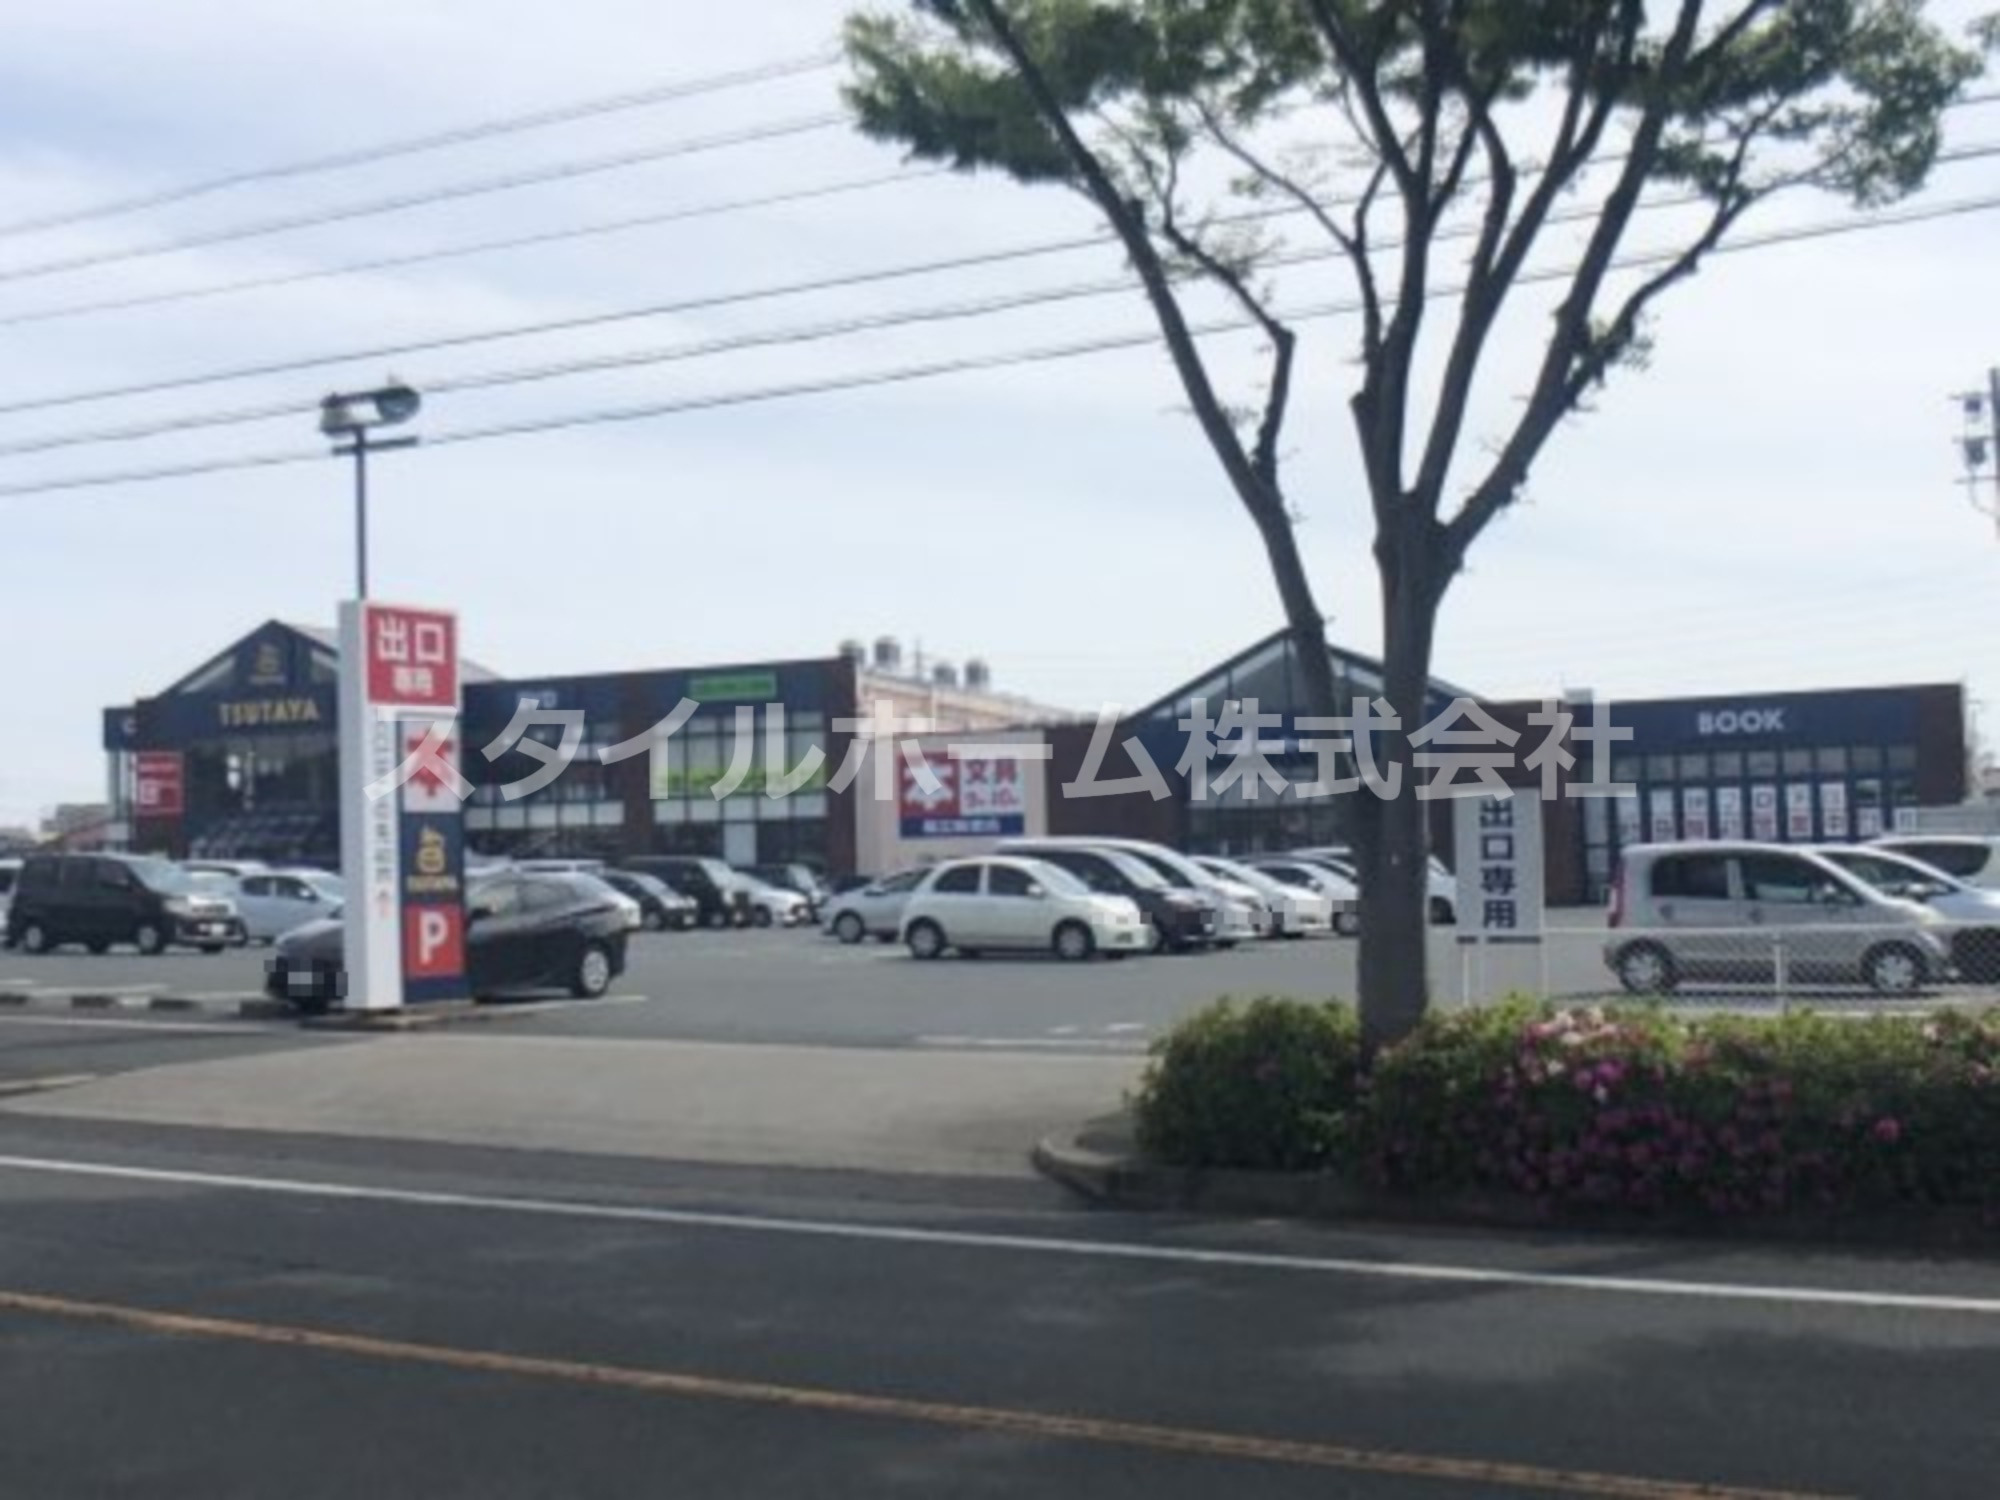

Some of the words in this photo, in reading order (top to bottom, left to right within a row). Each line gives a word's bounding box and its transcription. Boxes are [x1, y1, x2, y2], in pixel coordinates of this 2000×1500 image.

[376, 615, 447, 664] 出口
[1698, 706, 1786, 735] BOOK
[1479, 793, 1517, 929] 出口専用
[419, 910, 449, 967] P
